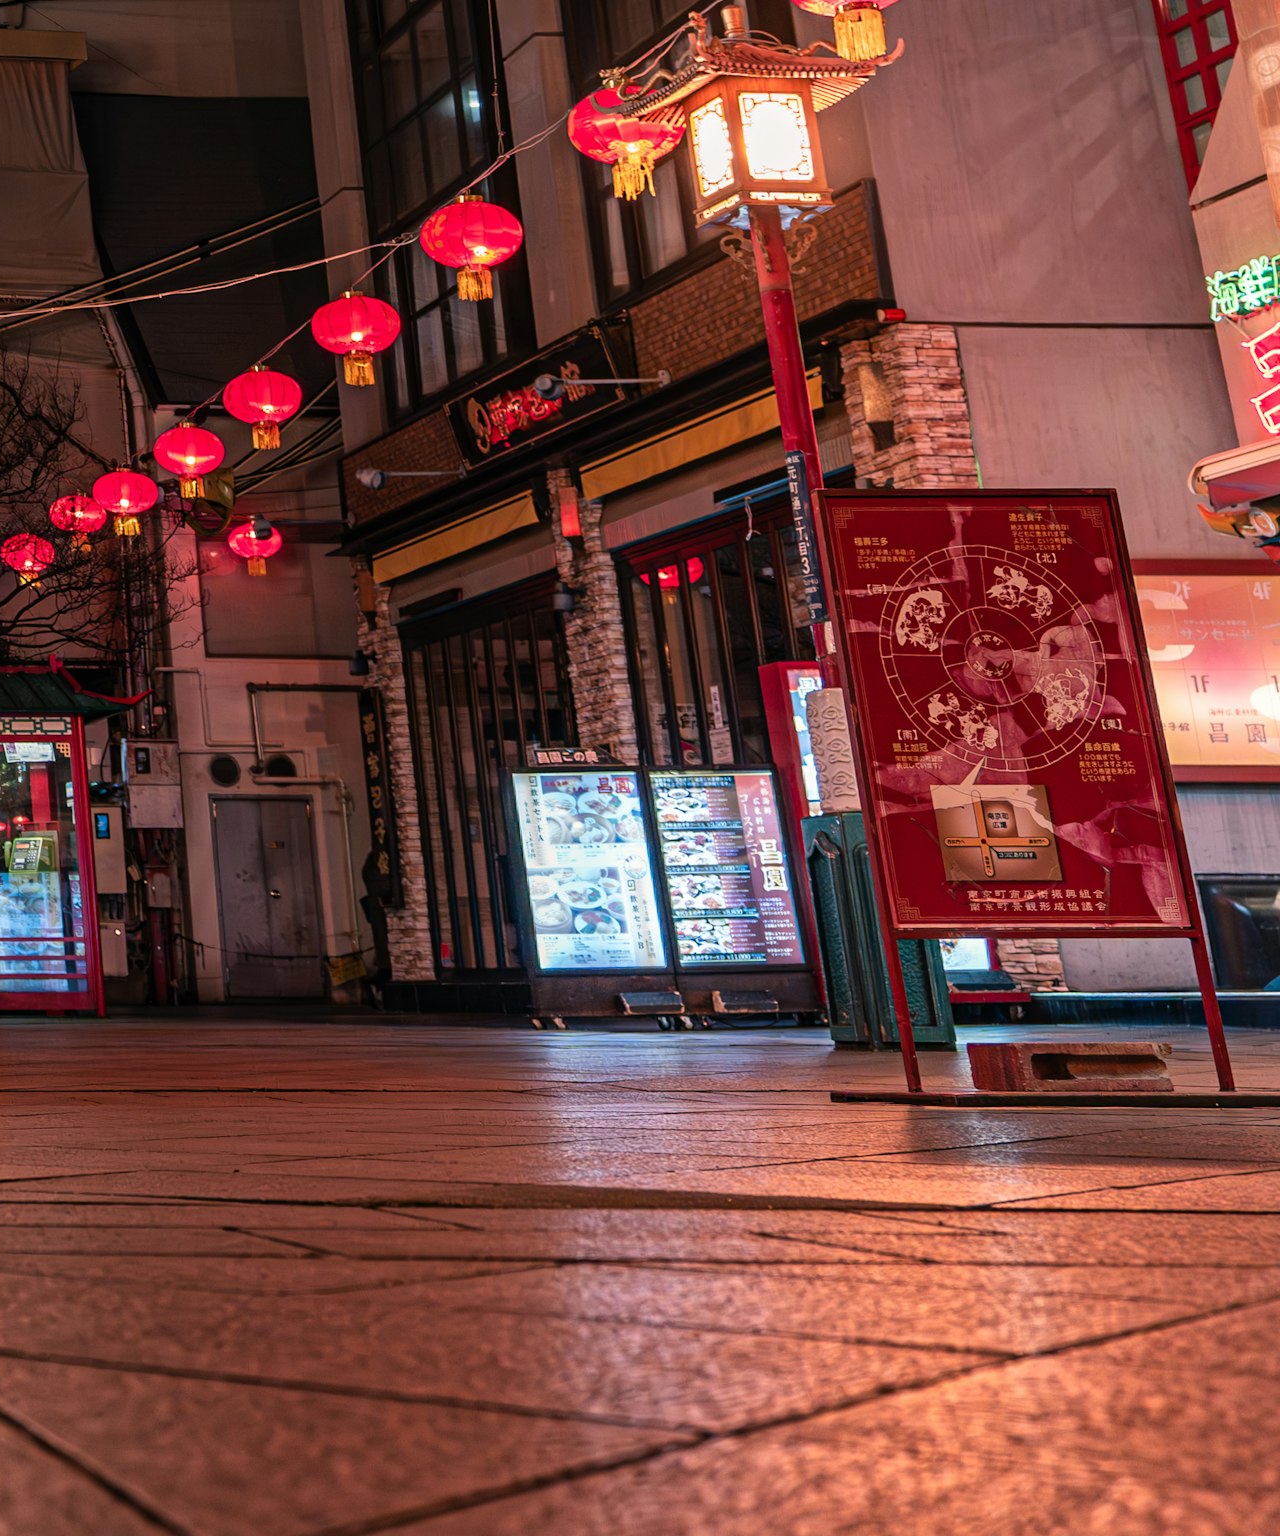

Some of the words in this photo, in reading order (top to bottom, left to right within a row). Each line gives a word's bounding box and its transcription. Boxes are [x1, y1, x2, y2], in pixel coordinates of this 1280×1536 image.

[1171, 580, 1192, 600] 2F
[1253, 581, 1272, 600] 4F
[1190, 674, 1210, 693] 1F
[1209, 722, 1268, 743] 昌園
[740, 794, 758, 868] コースメニュー
[759, 838, 788, 892] 昌園
[967, 889, 1106, 900] 南京町商店街振興組合
[969, 901, 1108, 912] 南京町景観形成協議会
